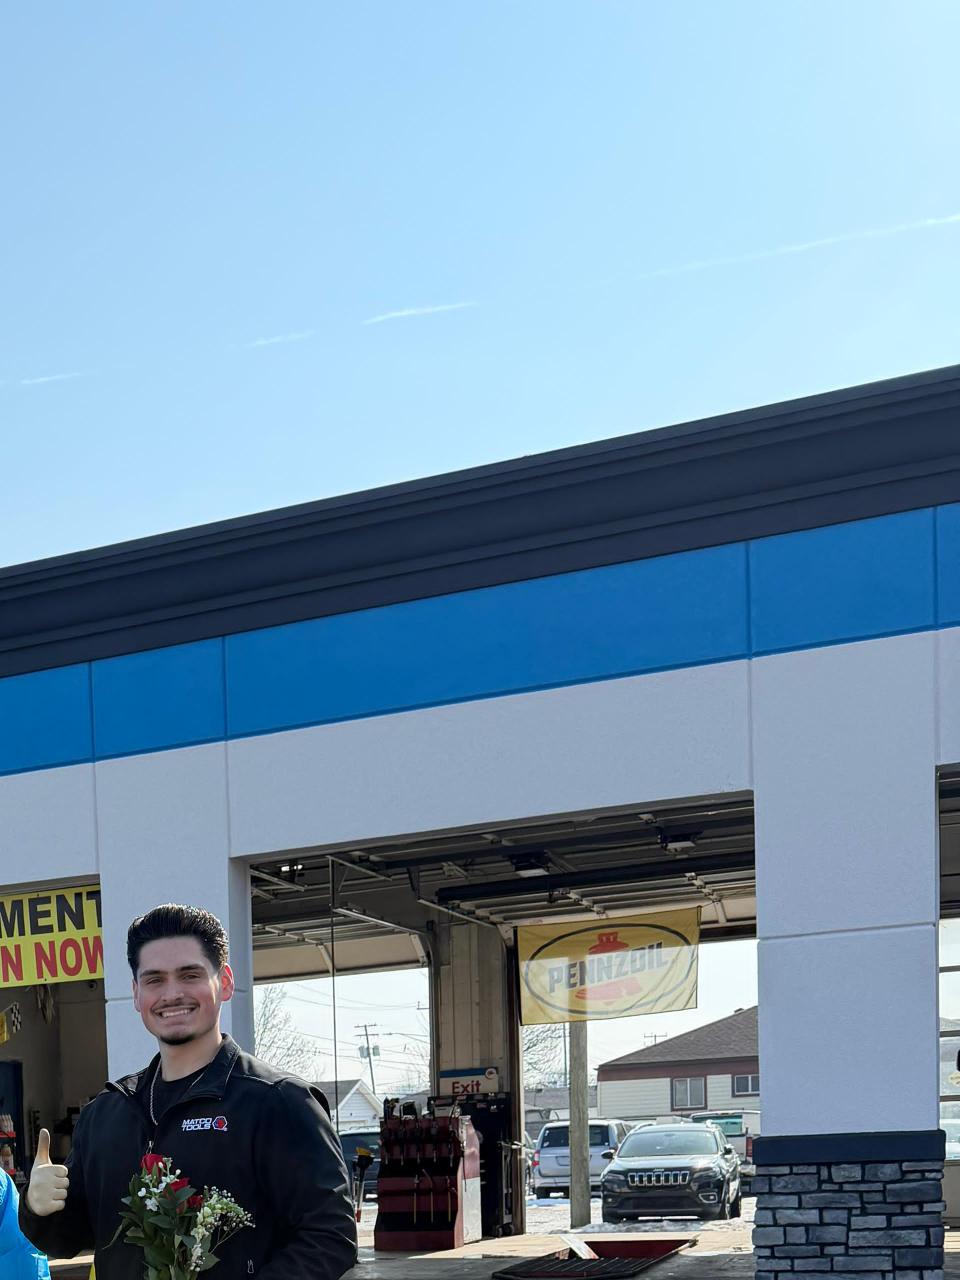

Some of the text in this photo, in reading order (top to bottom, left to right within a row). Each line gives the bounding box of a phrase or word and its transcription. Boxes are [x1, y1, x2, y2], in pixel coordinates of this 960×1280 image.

[34, 935, 104, 980] NOW
[548, 941, 669, 994] PENNZOIL
[452, 1080, 481, 1094] Exit
